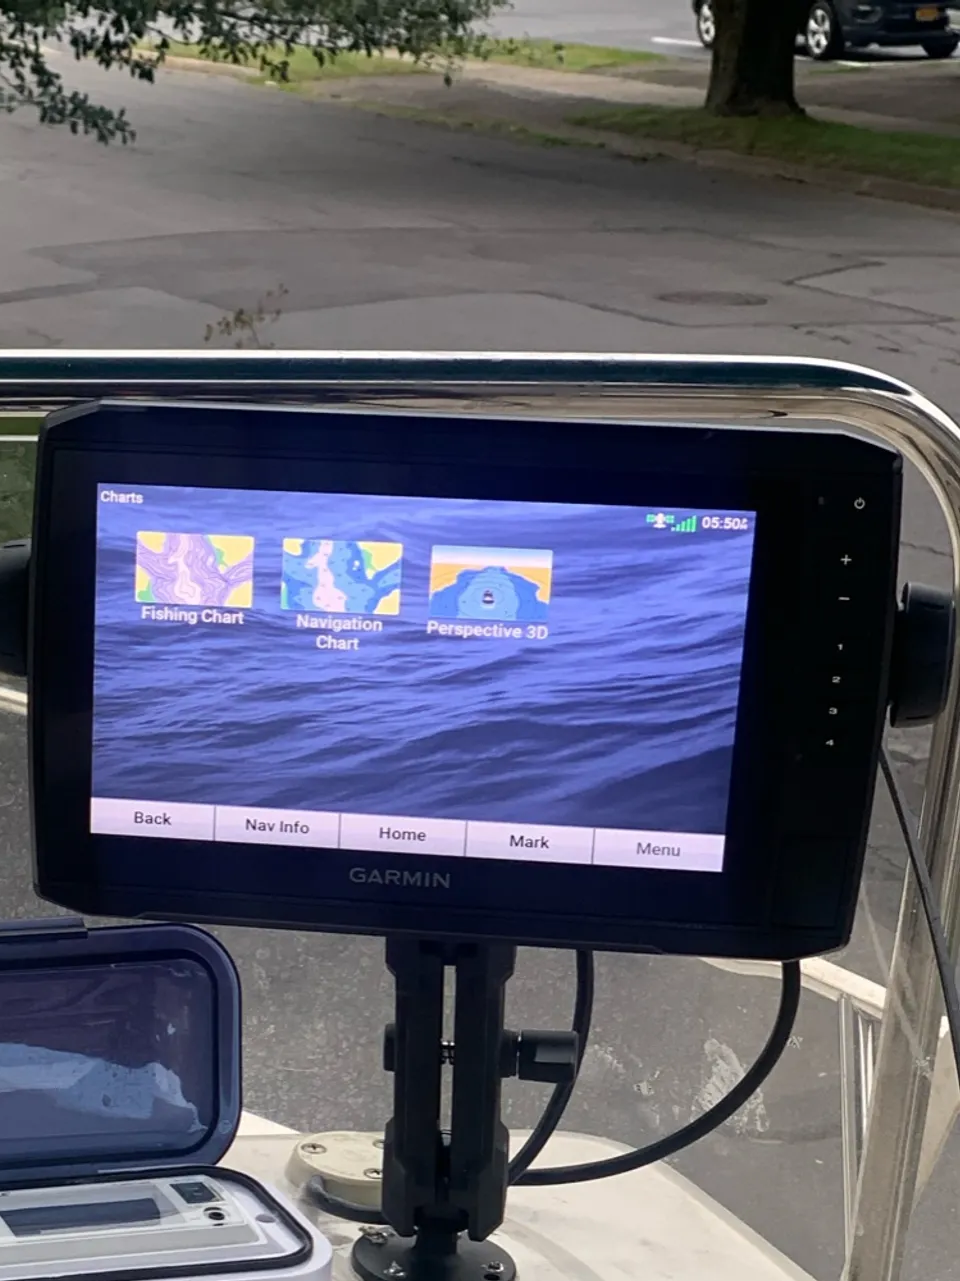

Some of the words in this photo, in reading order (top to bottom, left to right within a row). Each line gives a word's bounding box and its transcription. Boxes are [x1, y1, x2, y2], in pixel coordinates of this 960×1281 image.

[100, 490, 144, 505] Charts
[141, 606, 197, 625] Fishing
[201, 608, 244, 625] Chart
[296, 613, 383, 633] Navigation
[427, 620, 522, 641] Perspective
[526, 624, 548, 641] 3D
[316, 635, 359, 651] Chart
[133, 811, 172, 827] Back
[244, 817, 275, 833] Nav
[279, 819, 310, 835] Info
[378, 826, 427, 842] Home
[509, 834, 550, 850] Mark
[635, 842, 681, 858] Menu
[348, 866, 451, 889] GARMIN
